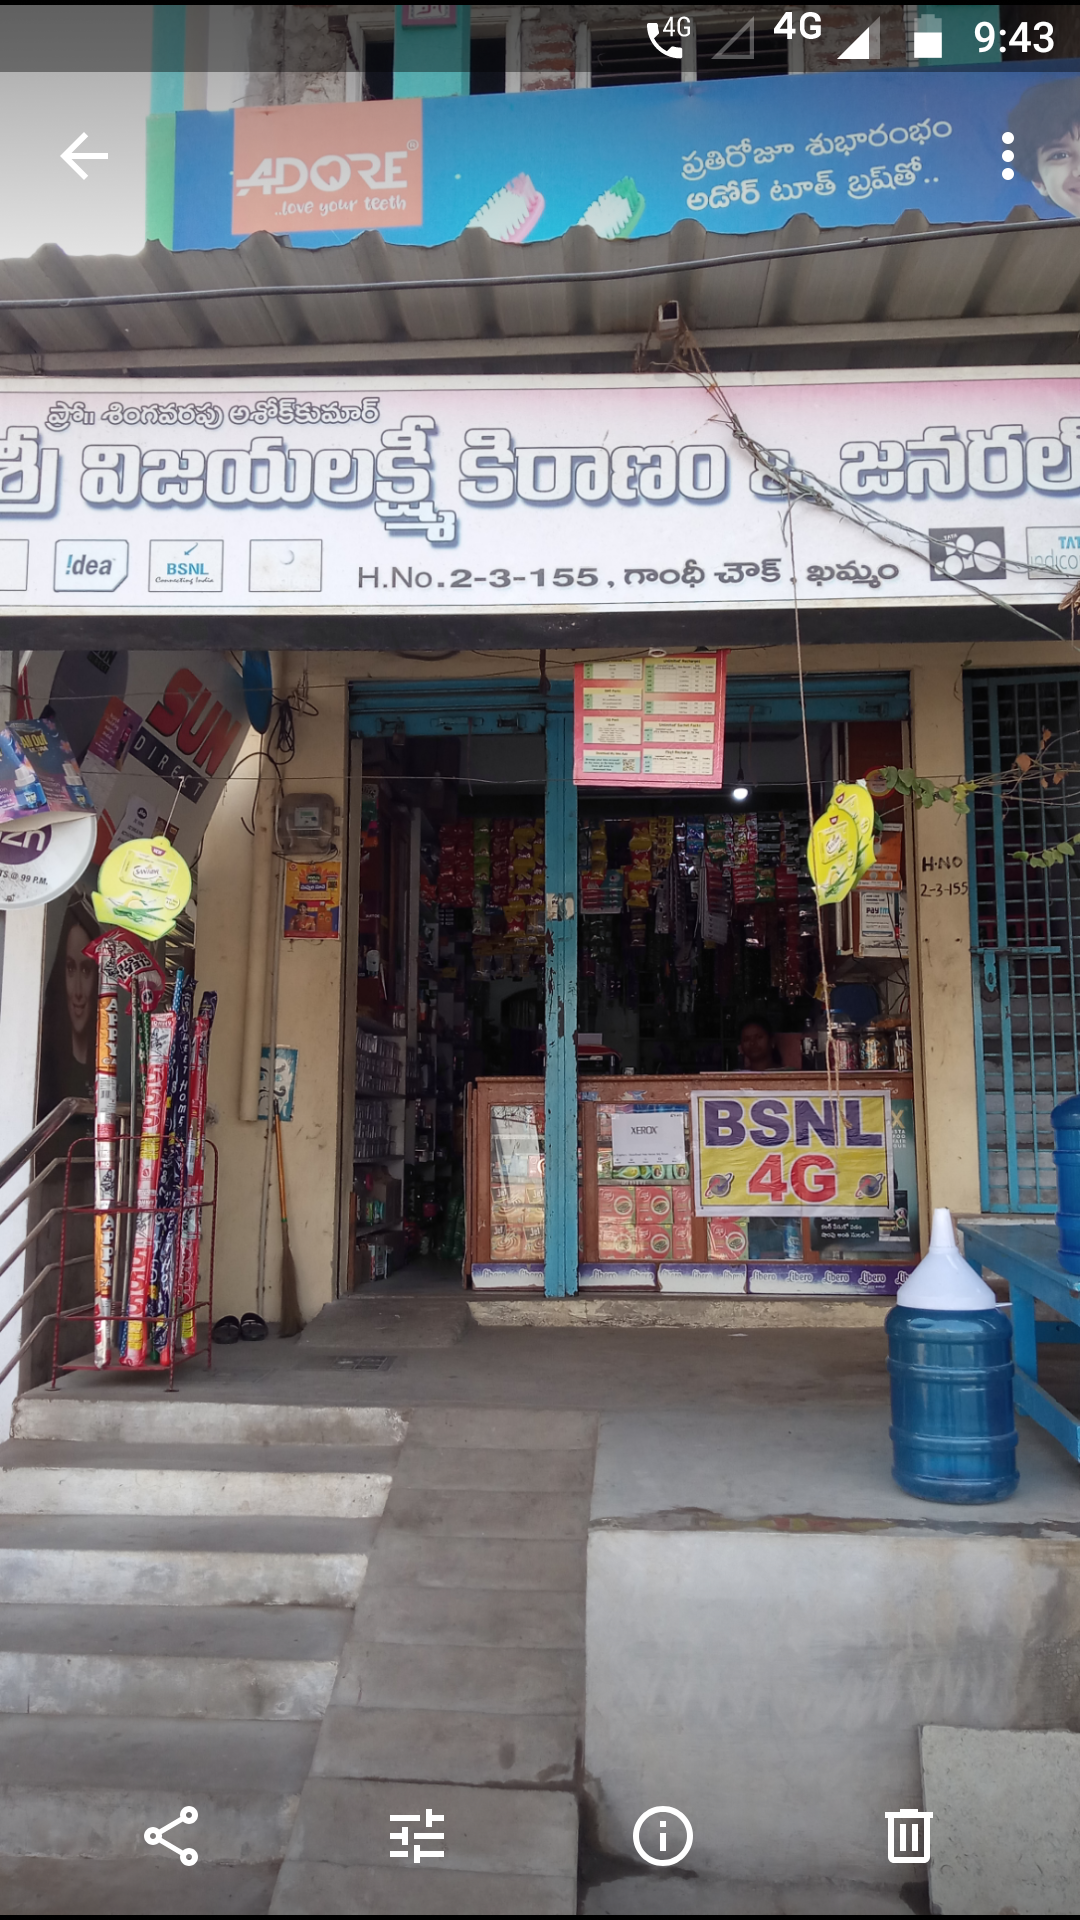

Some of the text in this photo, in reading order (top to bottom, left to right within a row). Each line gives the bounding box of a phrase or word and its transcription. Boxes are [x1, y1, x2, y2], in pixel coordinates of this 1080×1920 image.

[681, 118, 953, 181] ప్రతిరోజూ శుభారంభం
[236, 151, 408, 197] ADORE
[686, 178, 761, 211] అడోర్
[770, 170, 836, 201] టూత్
[319, 199, 359, 217] your
[364, 194, 407, 212] teeth
[166, 562, 210, 576] BSNL
[145, 668, 242, 777] SUN
[152, 847, 164, 855] NEW
[21, 873, 32, 883] 99
[920, 880, 969, 898] 2-3-155
[630, 1125, 658, 1135] XEROX
[703, 1098, 884, 1148] BSNL
[748, 1153, 840, 1204] 4G
[787, 1269, 814, 1283] Libero
[822, 1269, 850, 1284] Libero
[858, 1270, 887, 1285] Libero
